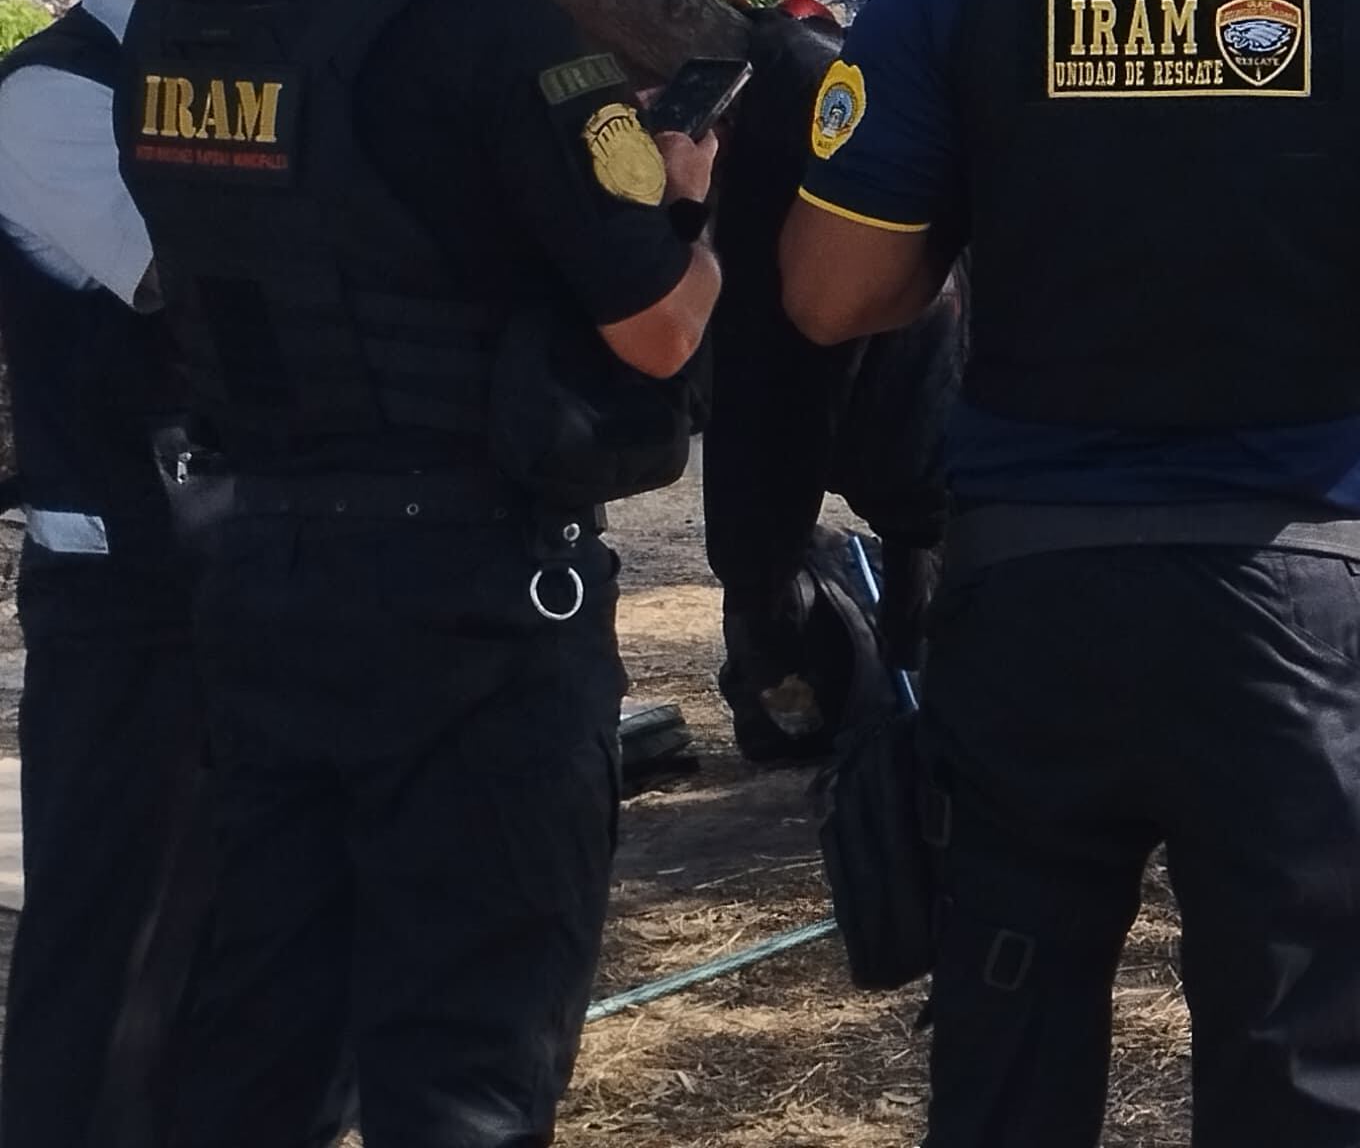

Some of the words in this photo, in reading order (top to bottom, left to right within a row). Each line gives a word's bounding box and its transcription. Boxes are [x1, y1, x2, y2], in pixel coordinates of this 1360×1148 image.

[1056, 61, 1116, 87] UNIDAD
[1125, 61, 1145, 86] DE
[1153, 59, 1224, 86] RESCATE
[142, 75, 283, 143] IRAM
